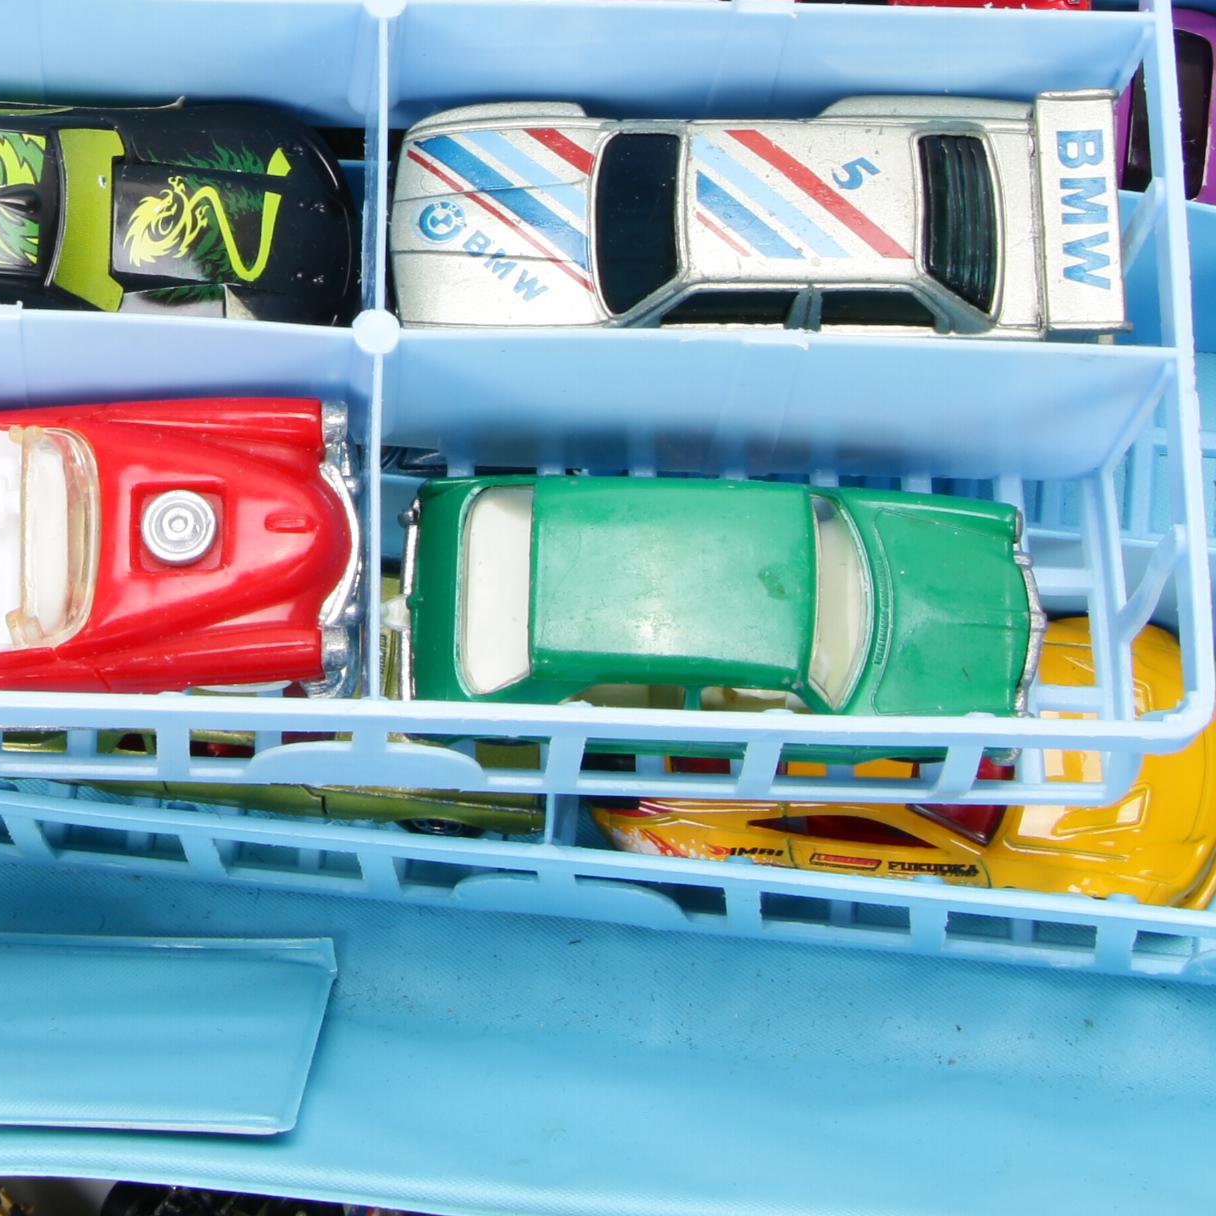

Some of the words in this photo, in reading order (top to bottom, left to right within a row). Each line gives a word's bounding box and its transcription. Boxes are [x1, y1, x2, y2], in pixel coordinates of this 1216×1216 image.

[831, 156, 882, 191] 5
[1055, 129, 1112, 290] BMW
[462, 229, 550, 302] BMW
